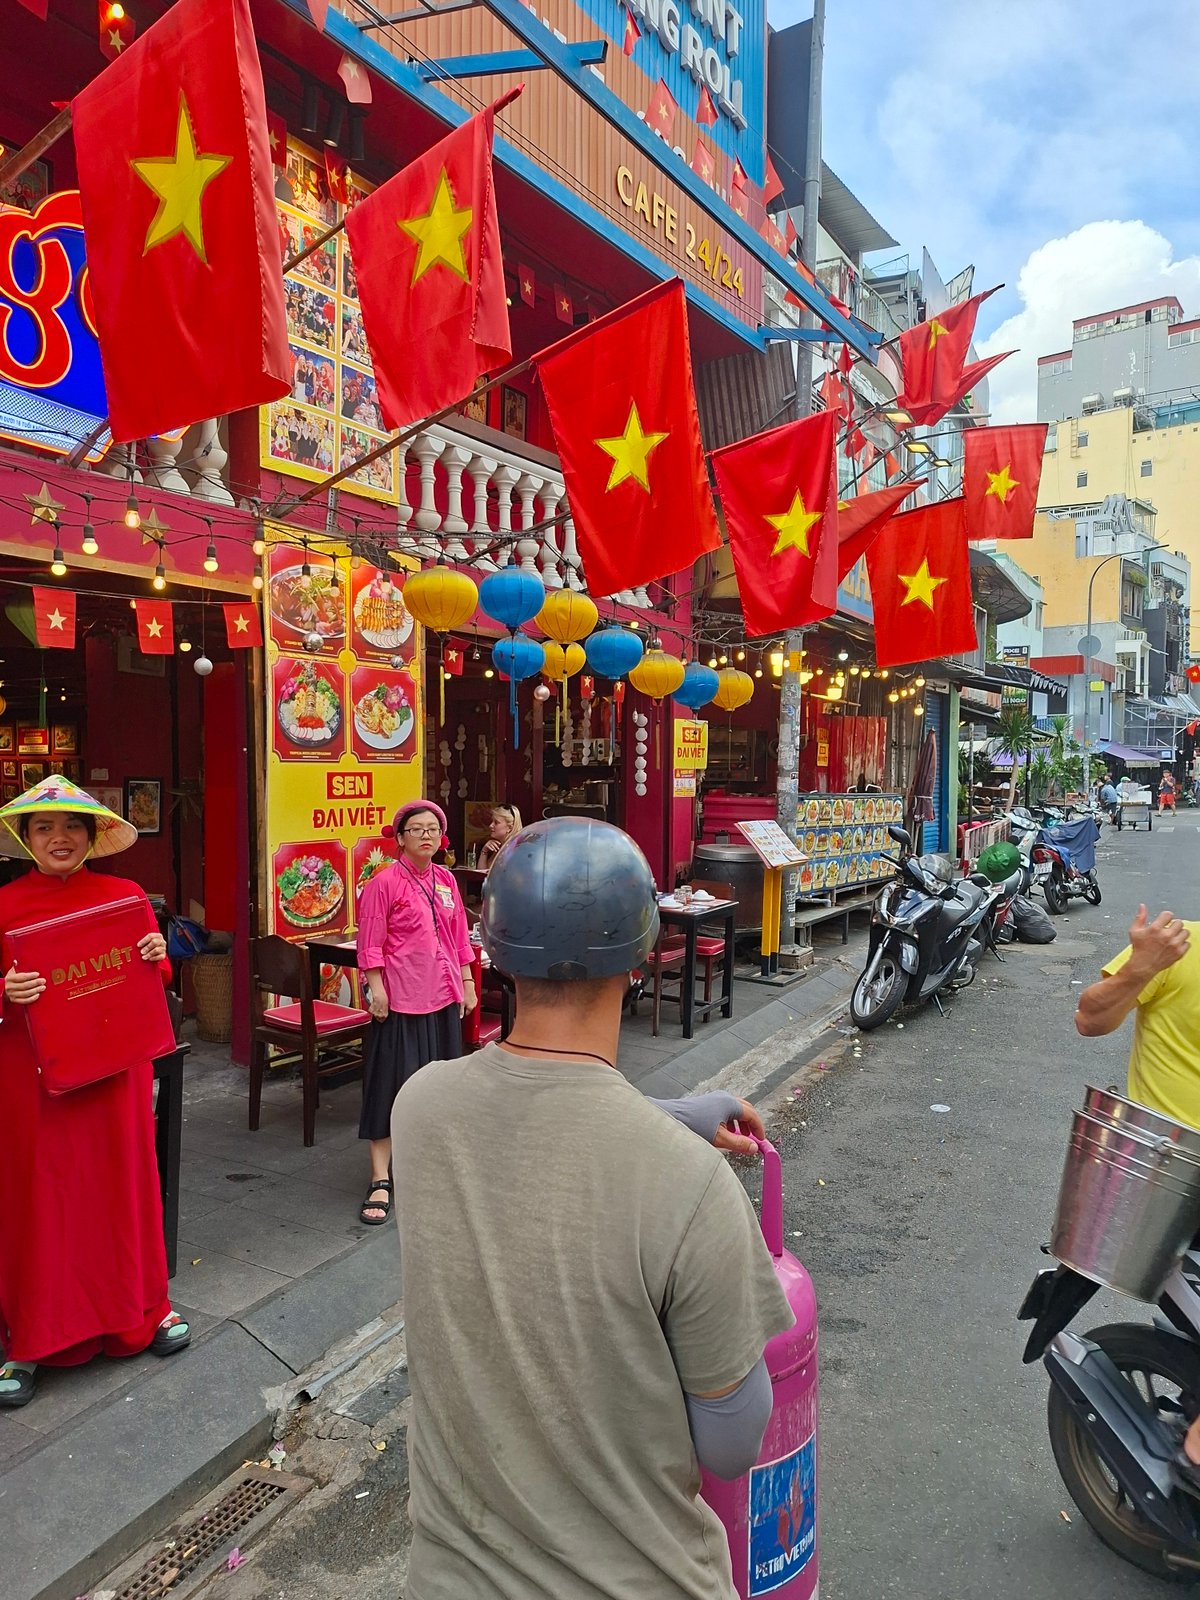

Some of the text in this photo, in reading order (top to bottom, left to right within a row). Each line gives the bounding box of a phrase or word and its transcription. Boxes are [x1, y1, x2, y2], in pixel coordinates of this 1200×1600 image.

[617, 165, 744, 299] CAFE 24/24
[332, 775, 368, 796] SEN
[313, 801, 386, 832] ĐẠI VIỆT
[90, 946, 133, 972] VIỆT
